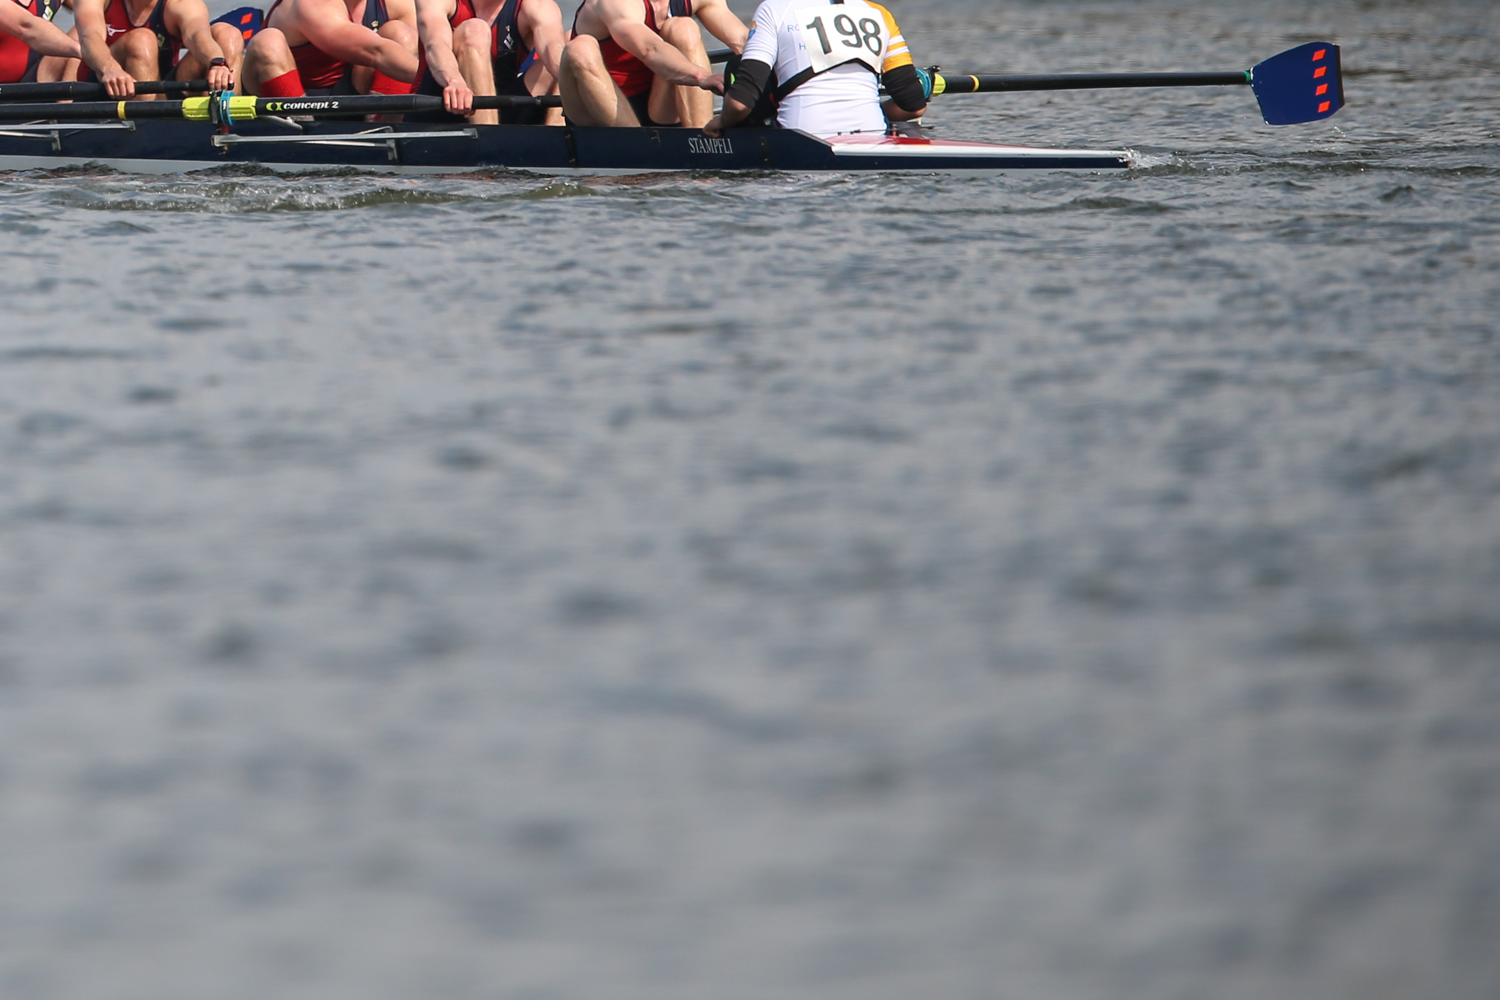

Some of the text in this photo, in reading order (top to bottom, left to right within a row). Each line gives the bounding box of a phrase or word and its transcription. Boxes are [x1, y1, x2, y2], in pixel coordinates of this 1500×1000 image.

[805, 13, 883, 57] 198
[283, 101, 339, 110] concept 2
[688, 134, 734, 154] STÄMPFLI
